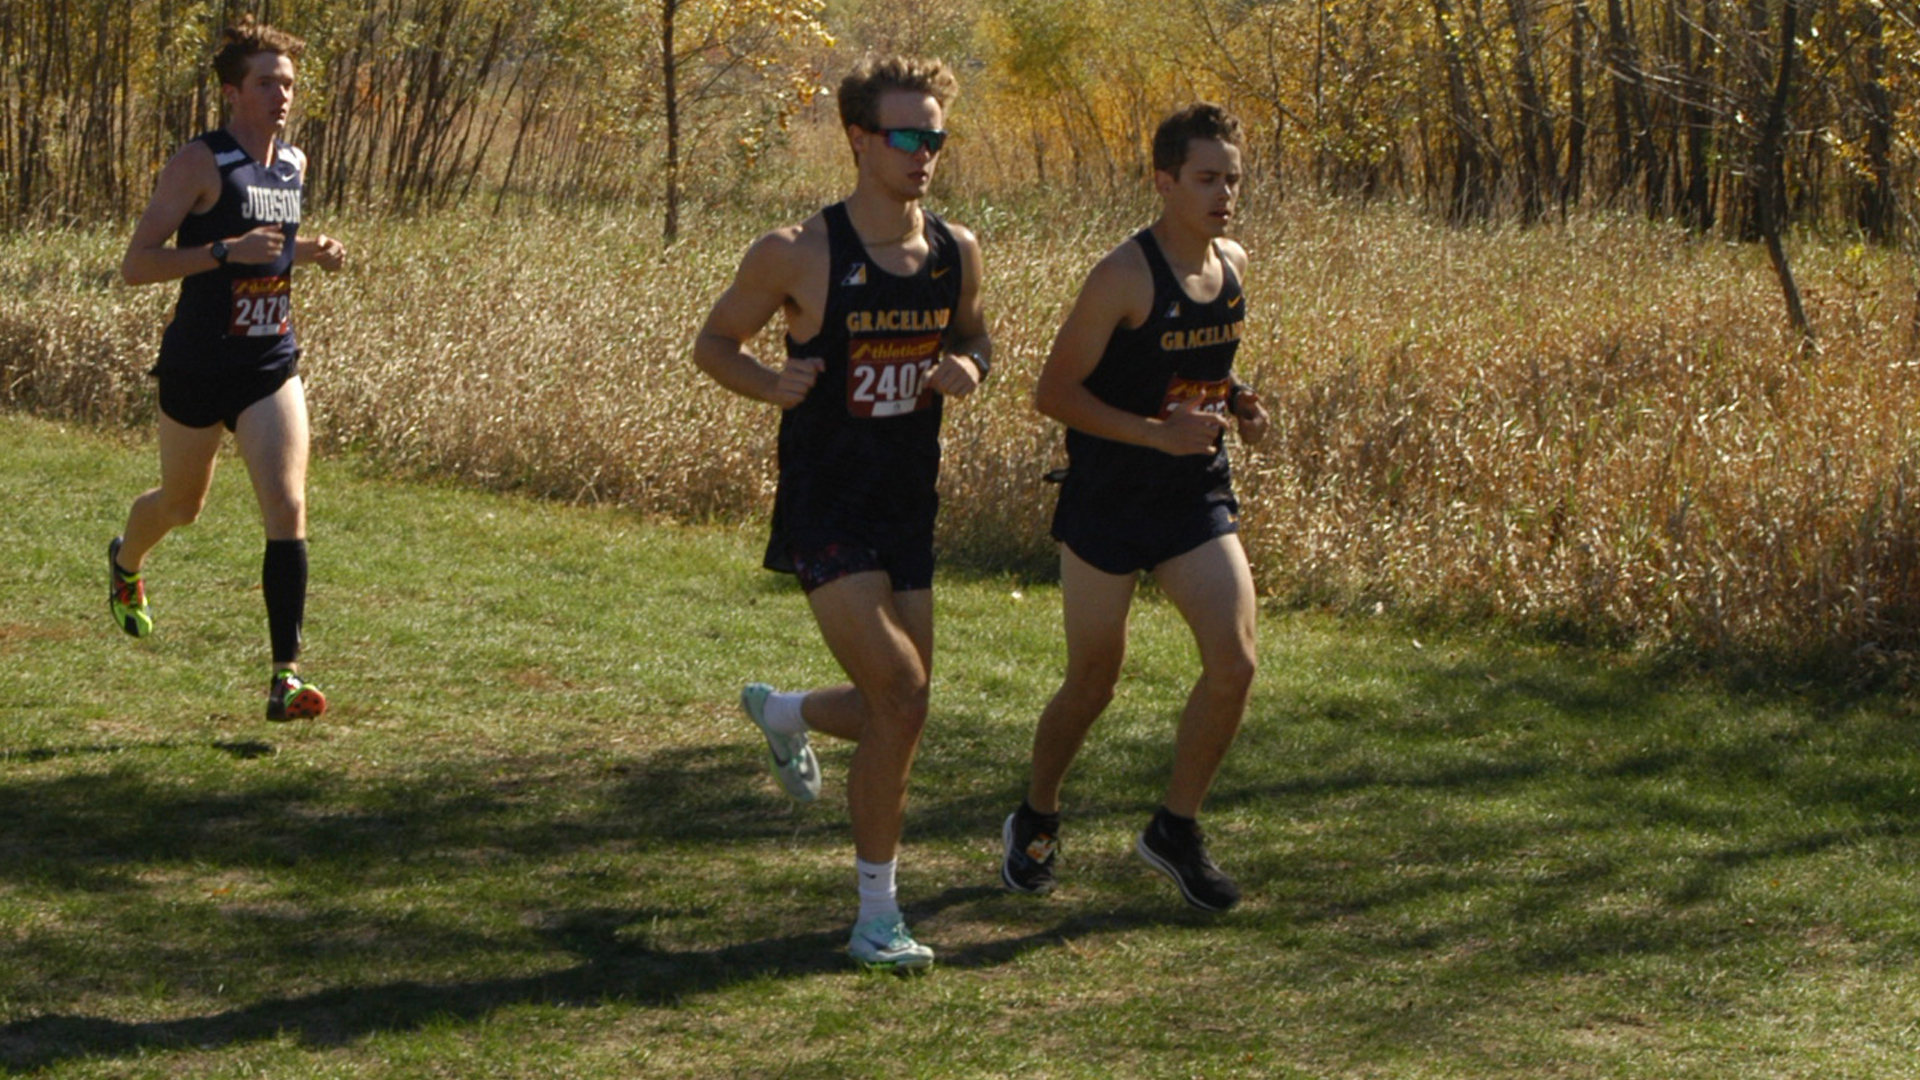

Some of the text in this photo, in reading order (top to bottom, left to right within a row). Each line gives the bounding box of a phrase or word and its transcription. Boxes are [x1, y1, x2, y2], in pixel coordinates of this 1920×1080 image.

[242, 185, 301, 224] JUDSON
[235, 295, 288, 326] 2478
[1160, 320, 1245, 352] GRACELAN
